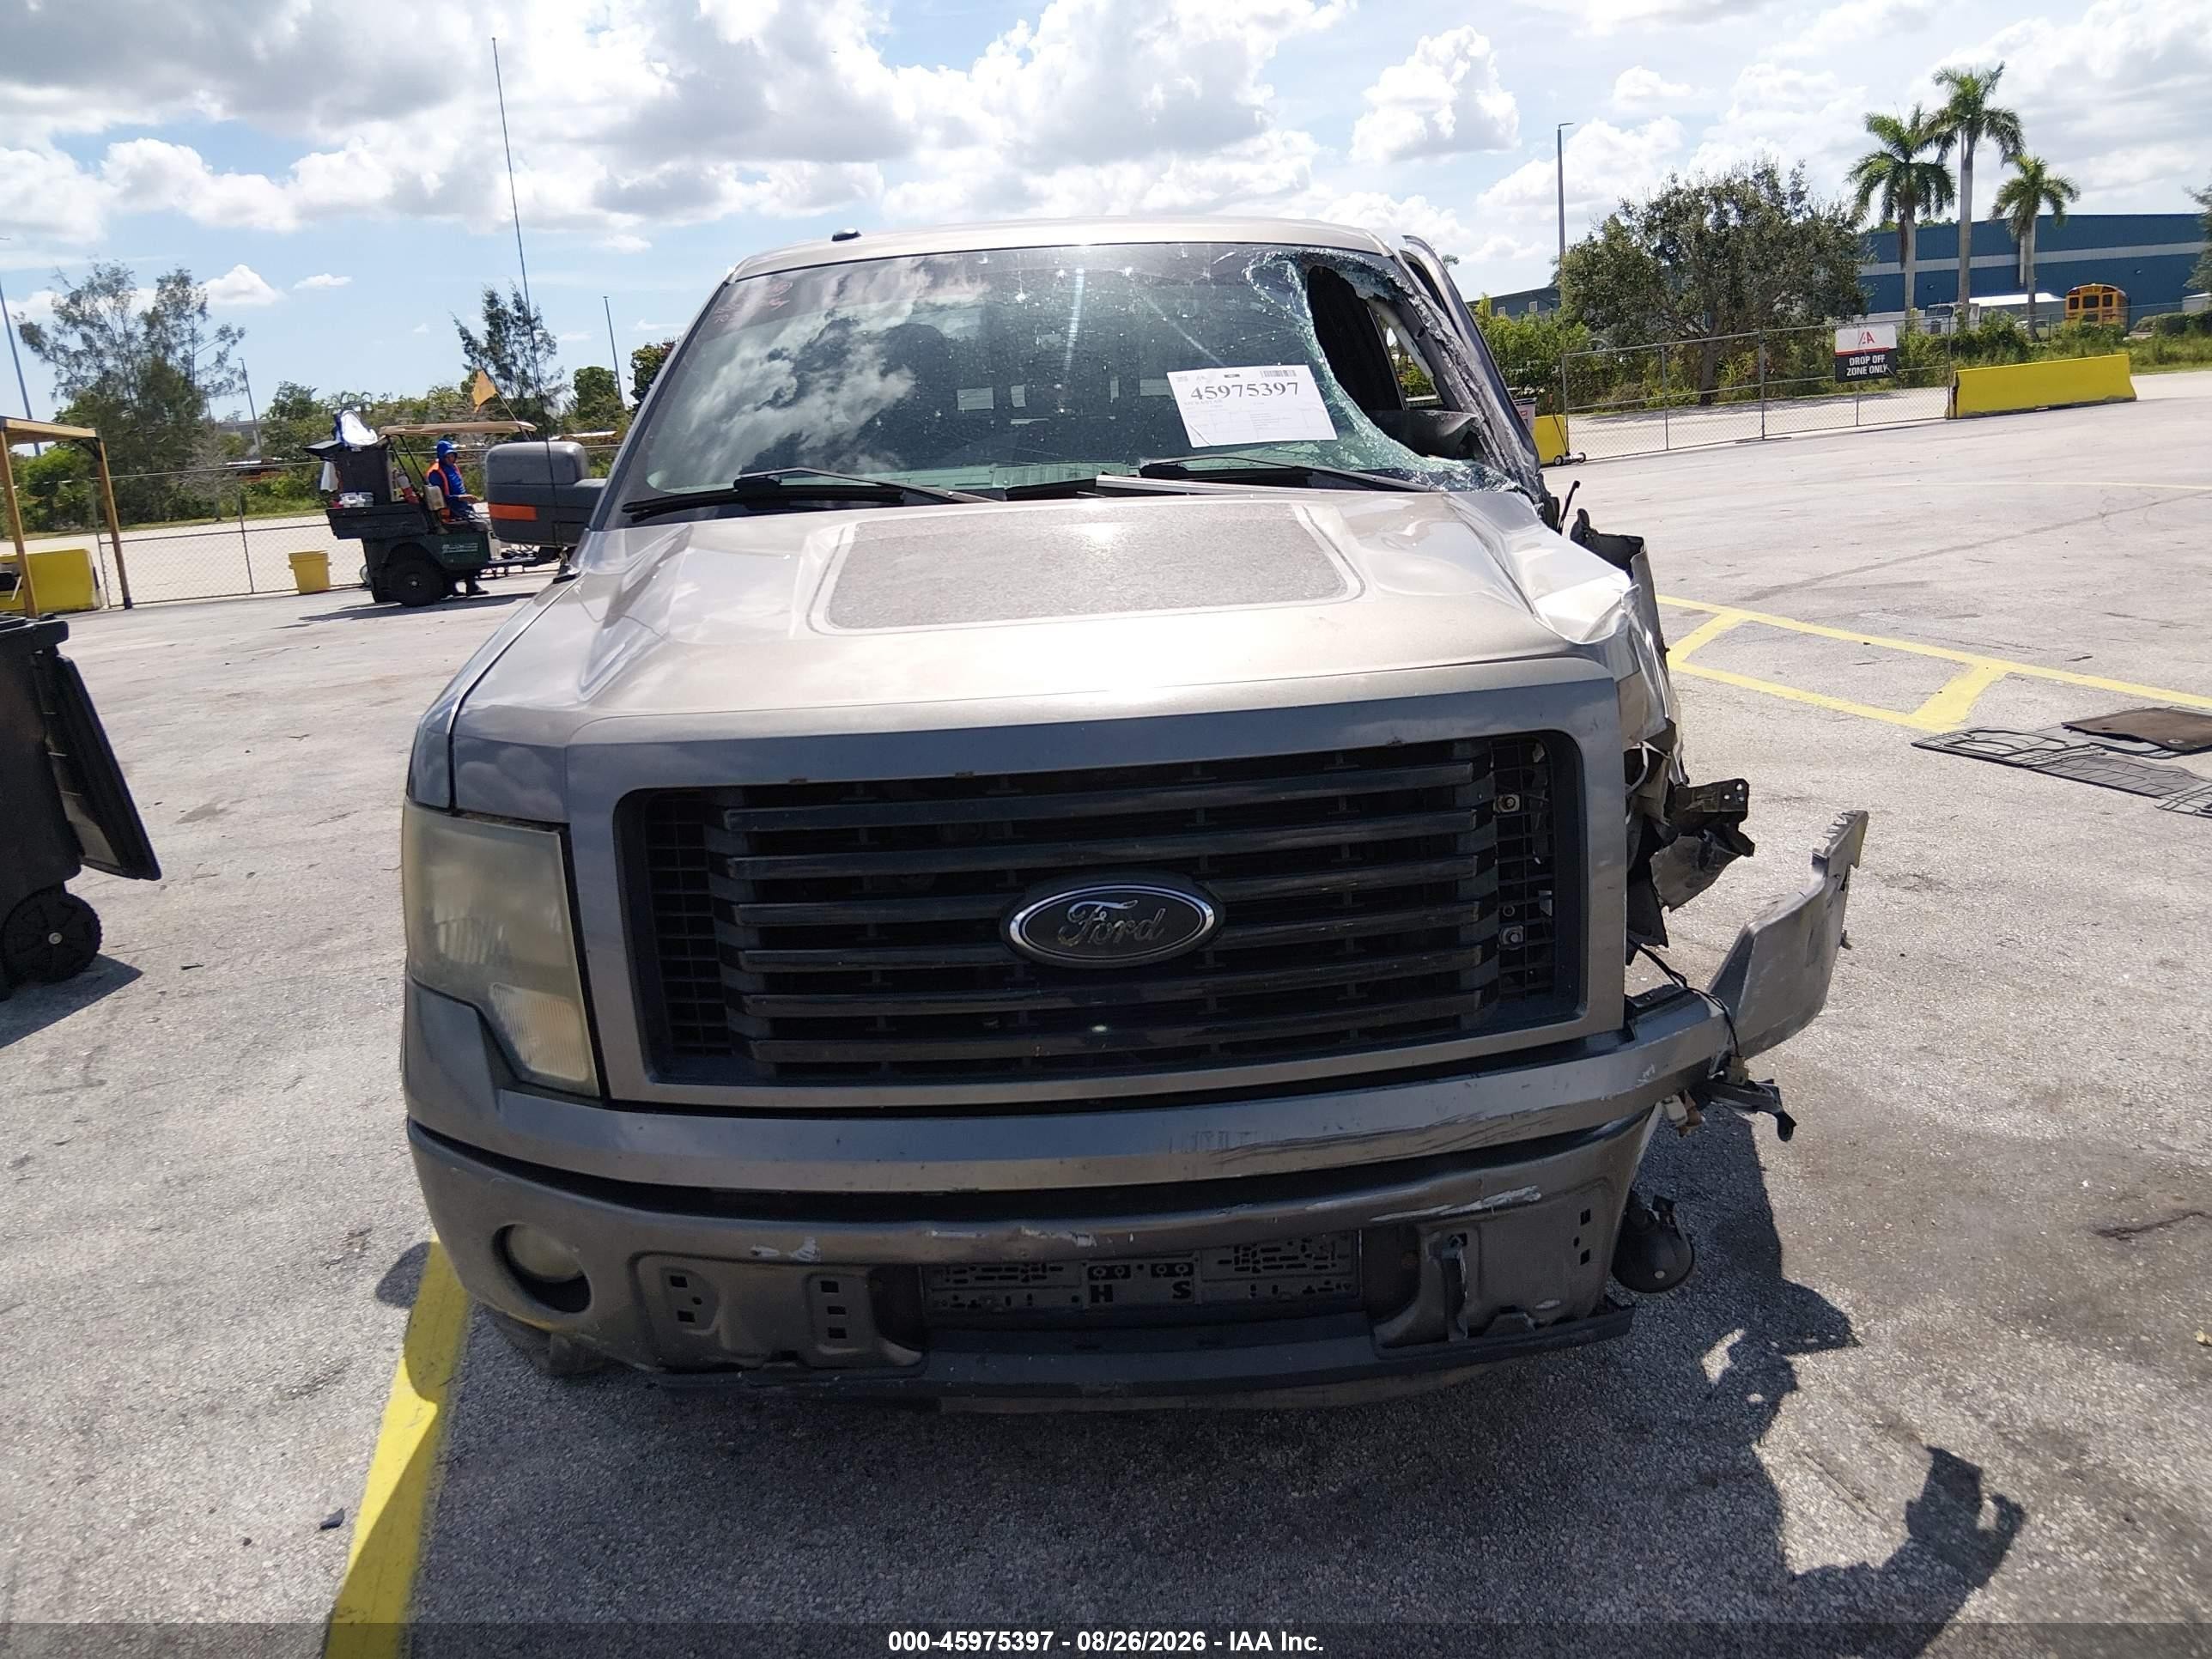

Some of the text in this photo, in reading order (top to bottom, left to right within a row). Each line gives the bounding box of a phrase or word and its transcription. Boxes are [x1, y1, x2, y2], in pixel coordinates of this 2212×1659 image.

[1849, 355, 1886, 366] DROP OFF
[1846, 364, 1887, 376] ZONE ONLY
[1191, 382, 1298, 400] 45975397
[1057, 899, 1166, 947] Ford
